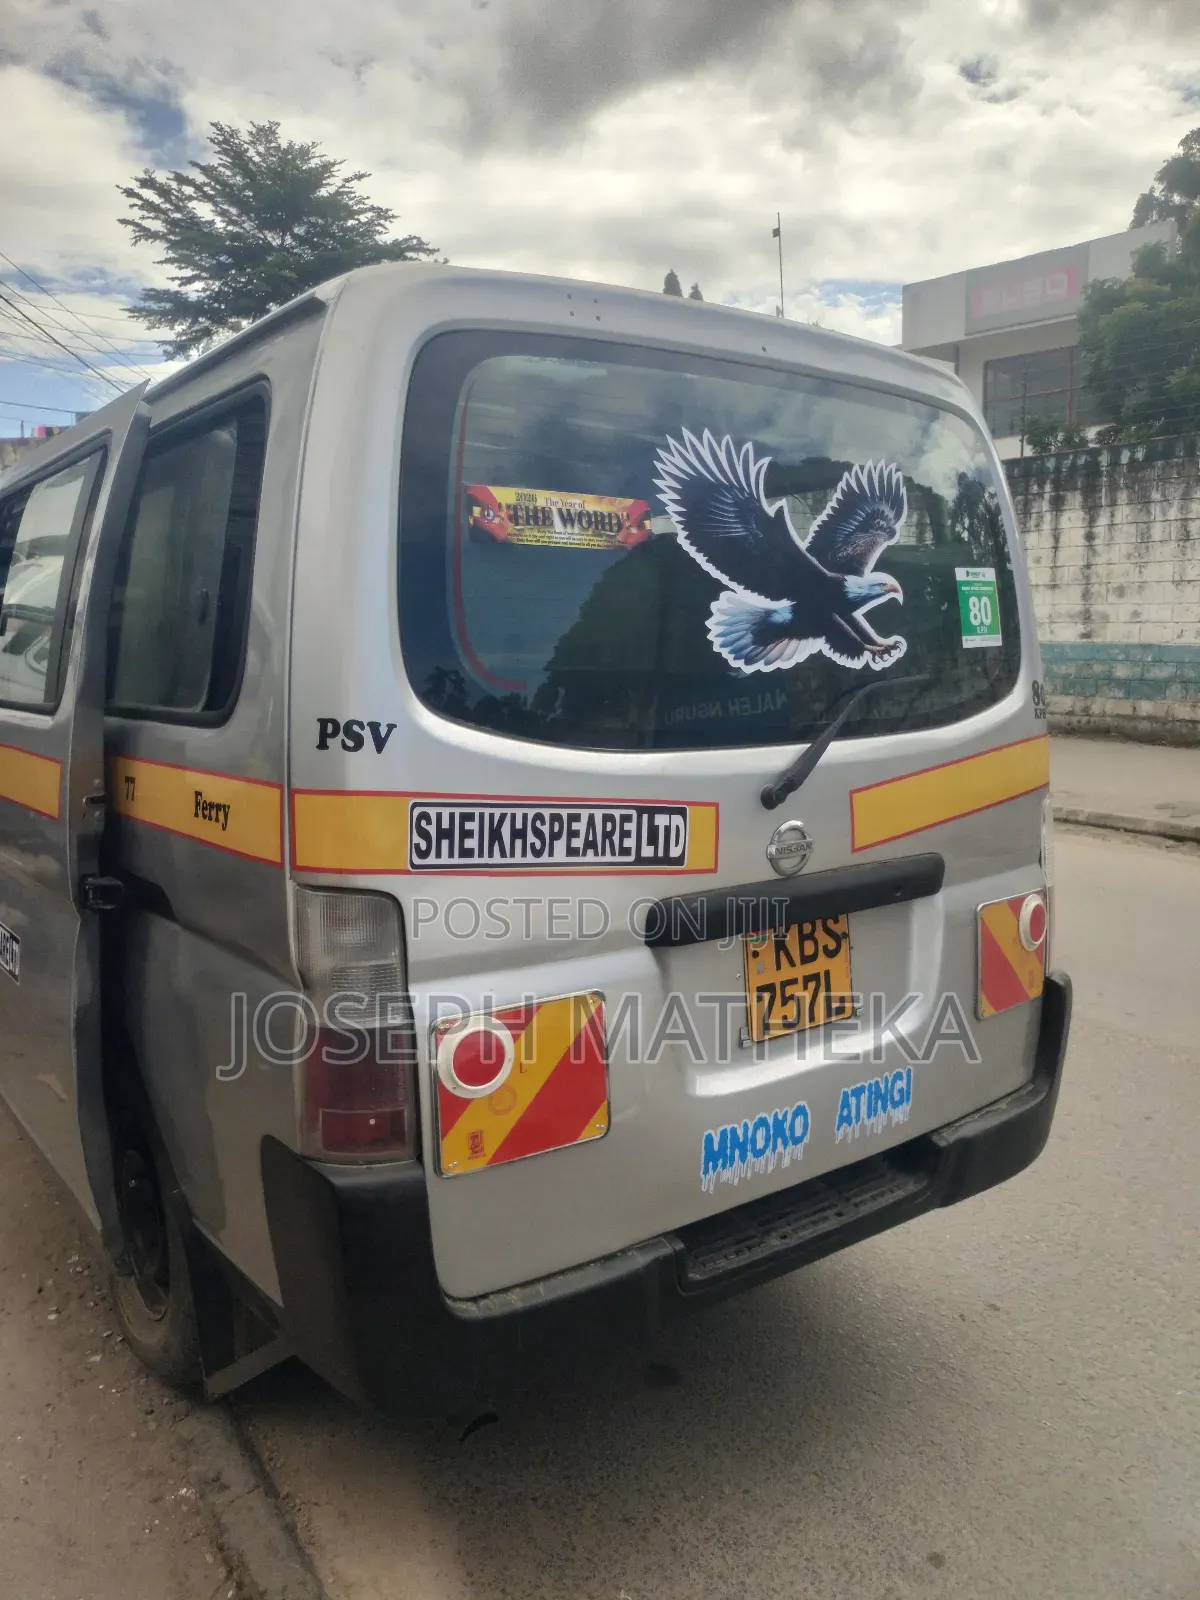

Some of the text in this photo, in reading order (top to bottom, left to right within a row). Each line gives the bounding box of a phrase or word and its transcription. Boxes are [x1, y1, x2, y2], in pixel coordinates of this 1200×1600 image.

[544, 497, 558, 507] The
[969, 596, 992, 626] 80
[1032, 680, 1046, 707] 80
[316, 717, 397, 754] PSV
[124, 775, 136, 801] 77
[194, 790, 231, 831] Ferry
[414, 811, 684, 860] SHEIKHSPEARE LTD
[772, 914, 842, 971] KBS
[756, 969, 845, 1036] 757L
[835, 1065, 913, 1142] ATINGI
[700, 1101, 811, 1192] MNOKO
